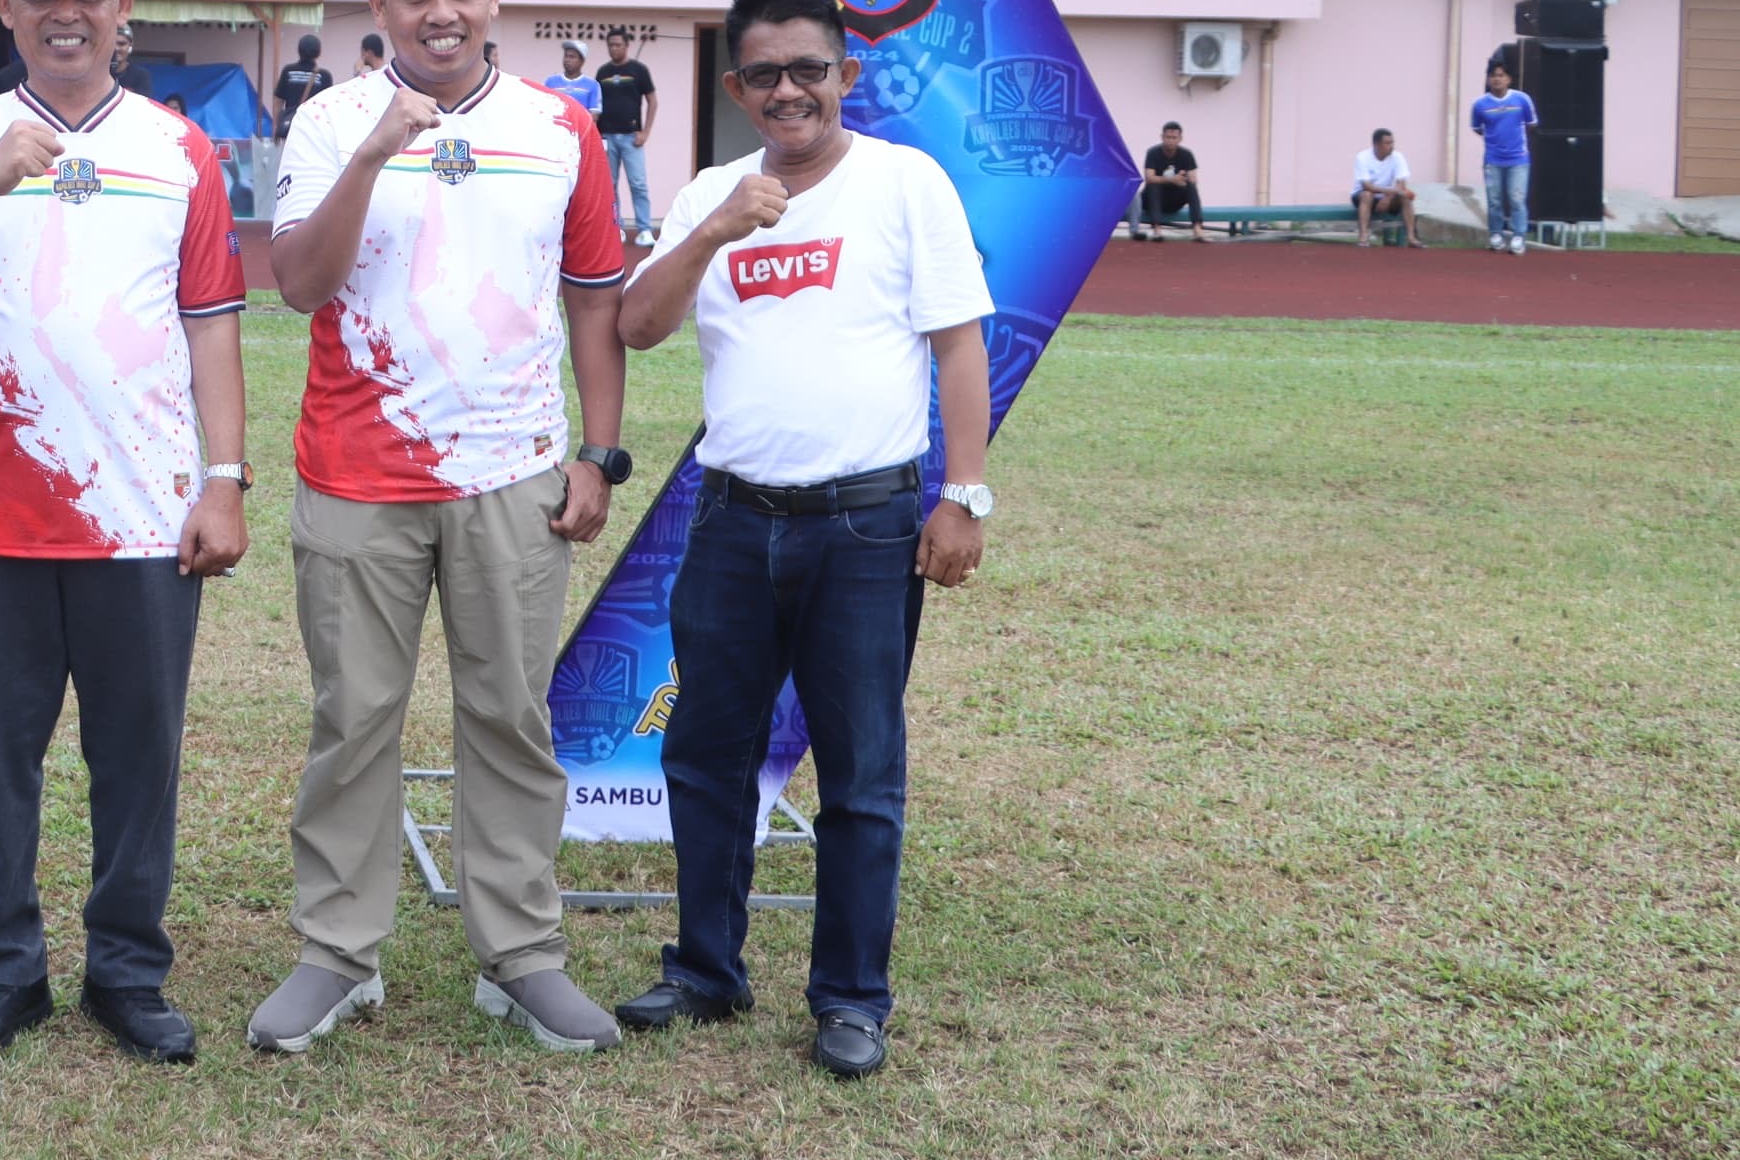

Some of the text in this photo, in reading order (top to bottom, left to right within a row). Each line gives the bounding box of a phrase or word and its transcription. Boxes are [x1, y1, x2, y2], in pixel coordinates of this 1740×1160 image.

[919, 11, 974, 55] CUP 2
[575, 786, 662, 806] SAMBU
